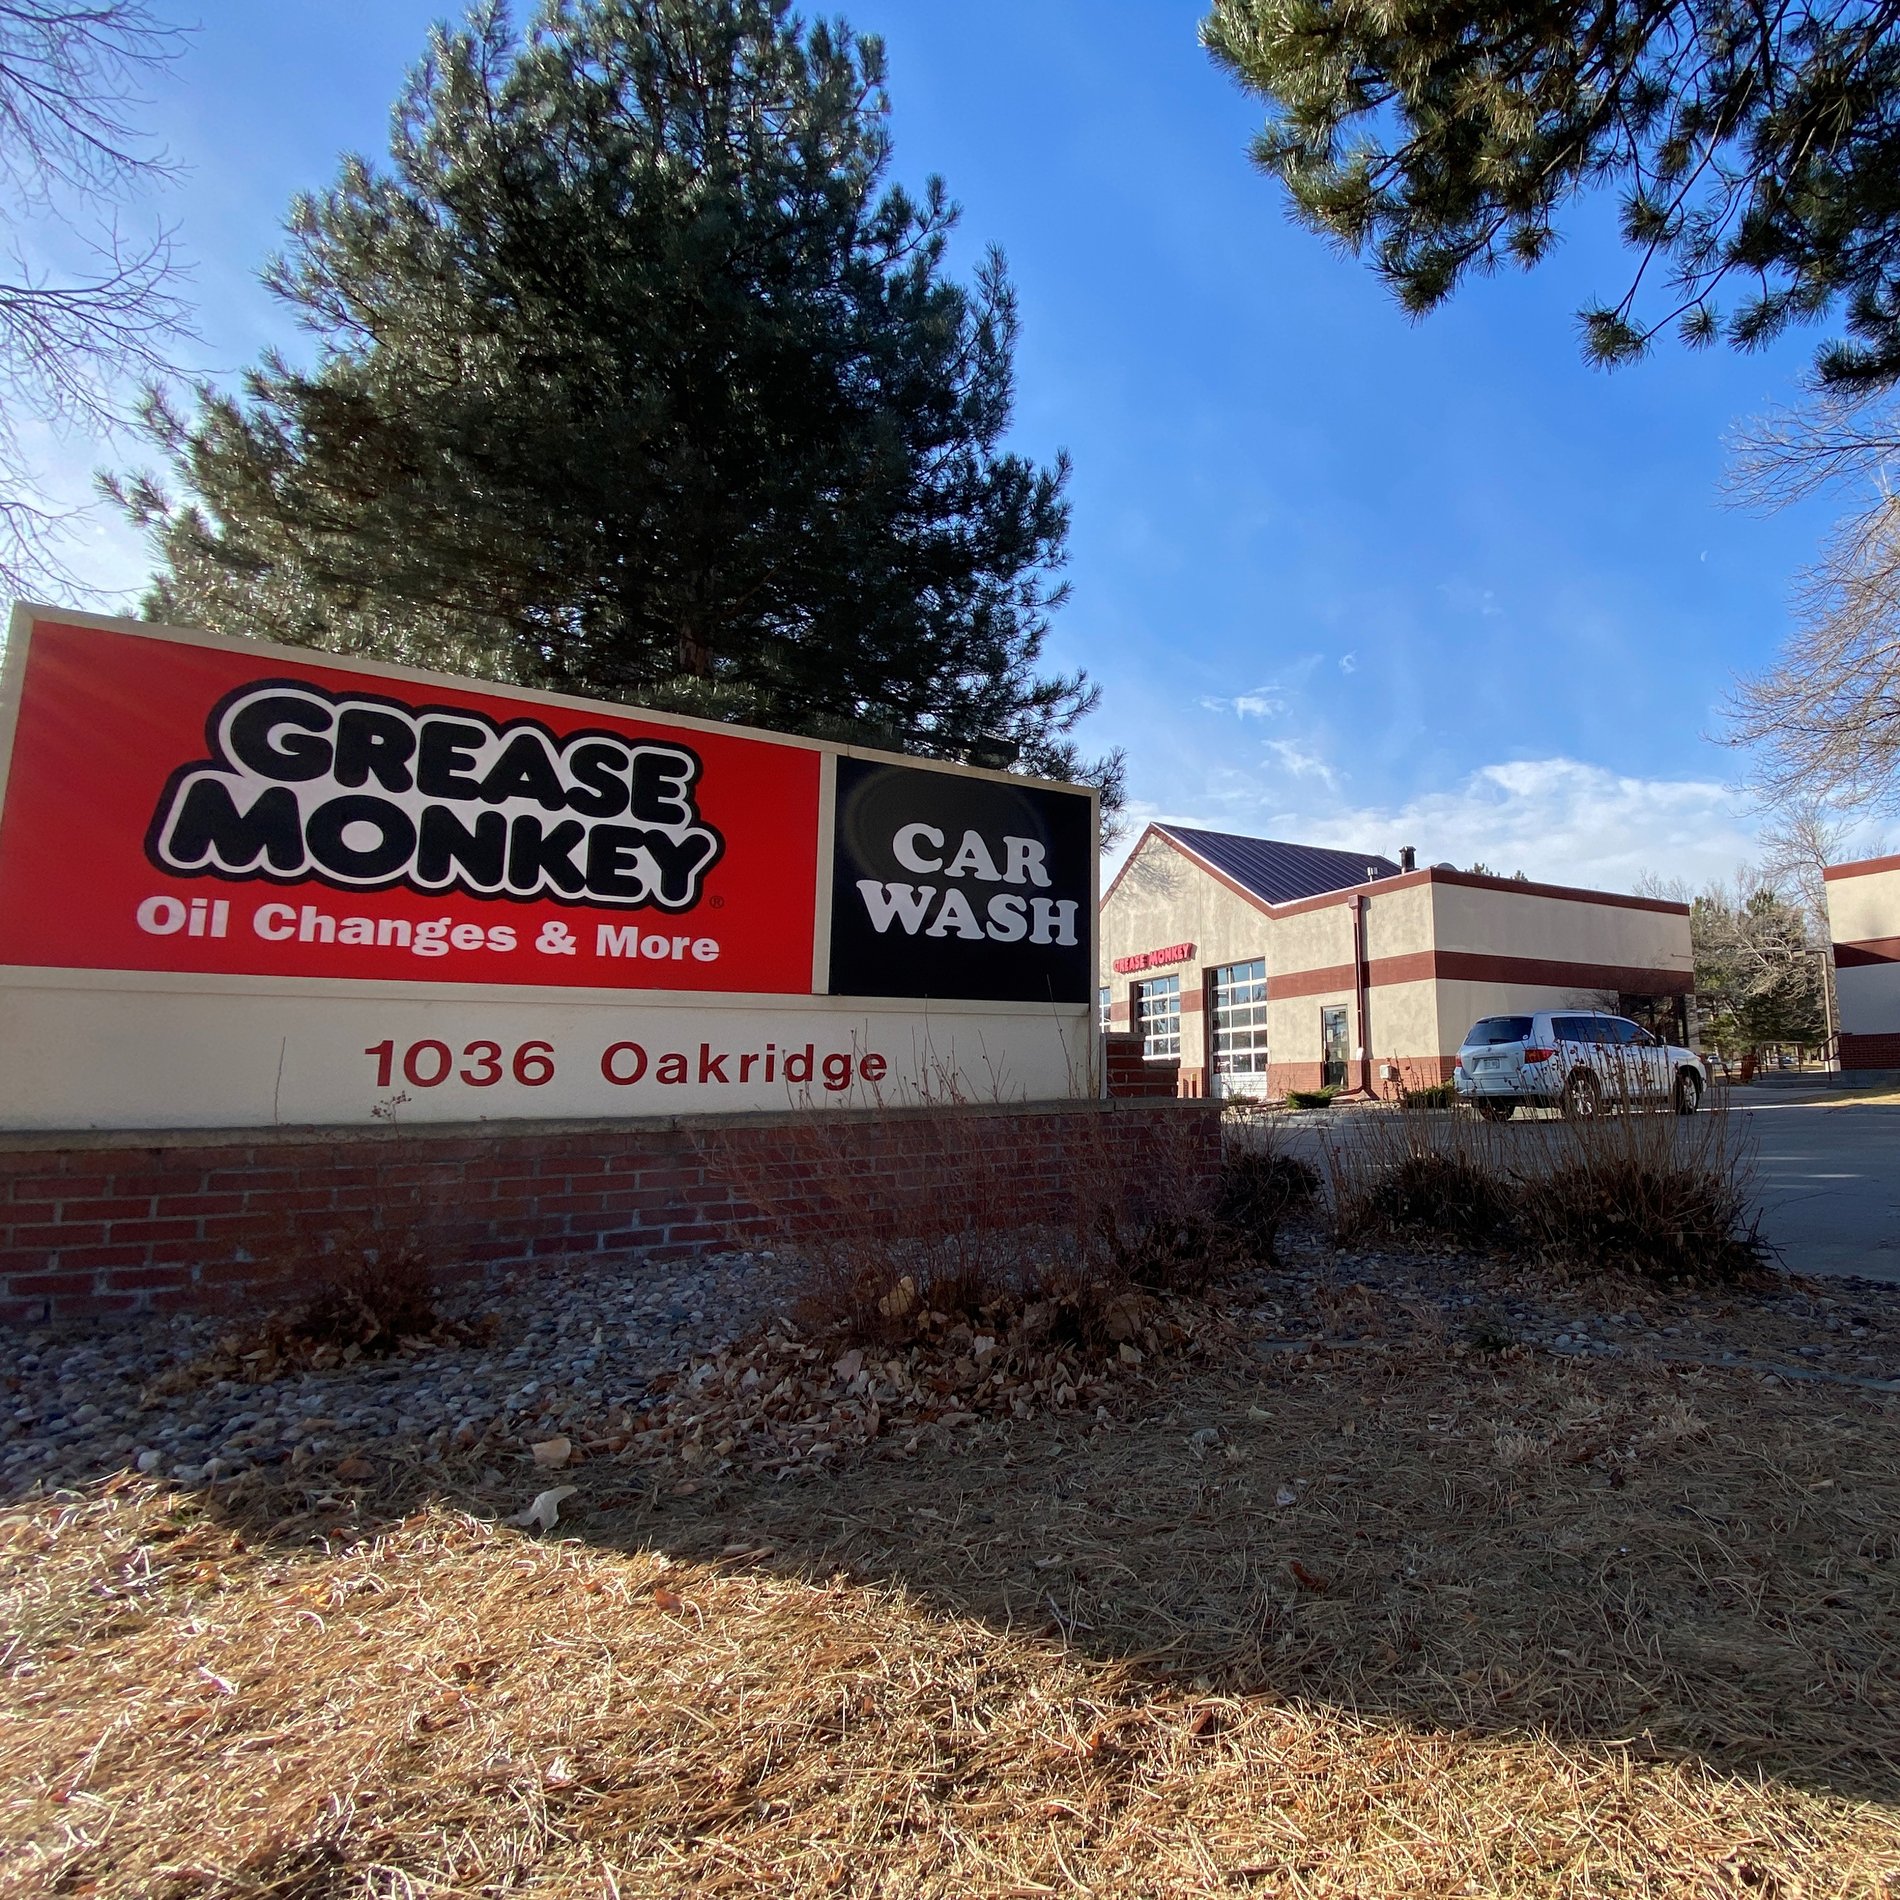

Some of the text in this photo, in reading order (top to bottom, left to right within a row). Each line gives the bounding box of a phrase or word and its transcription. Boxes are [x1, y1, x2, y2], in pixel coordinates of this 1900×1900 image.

[229, 695, 690, 825] GREASE
[168, 778, 712, 902] MONKEY
[892, 822, 1052, 887] CAR
[137, 895, 720, 962] Oil Changes & More
[856, 879, 1079, 946] WASH
[1113, 943, 1191, 973] GREASE MONKEY
[365, 1039, 888, 1091] 1036 Oakridge
